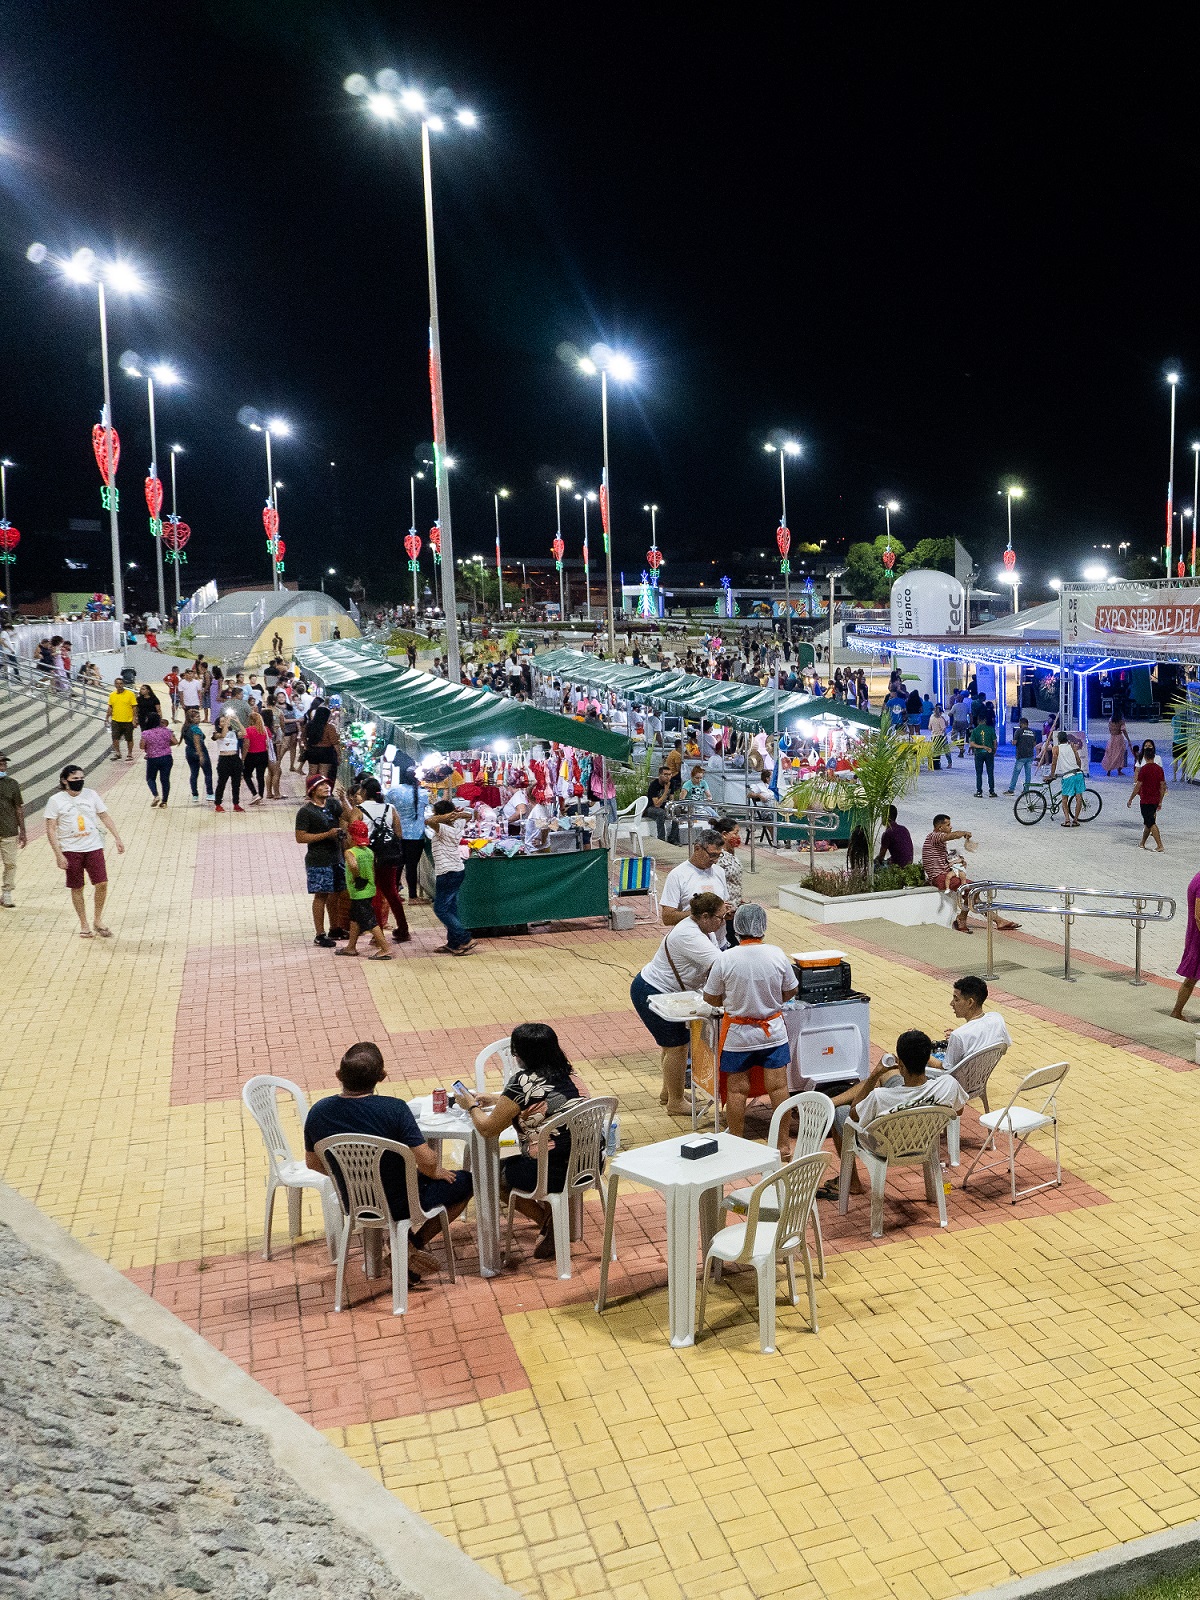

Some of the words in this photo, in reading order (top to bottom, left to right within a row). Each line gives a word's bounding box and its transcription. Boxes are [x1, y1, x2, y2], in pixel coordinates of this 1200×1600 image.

[896, 593, 903, 608] do
[904, 588, 913, 630] Branco
[1098, 607, 1127, 630] EXPO
[1130, 607, 1171, 631] SEBRAE
